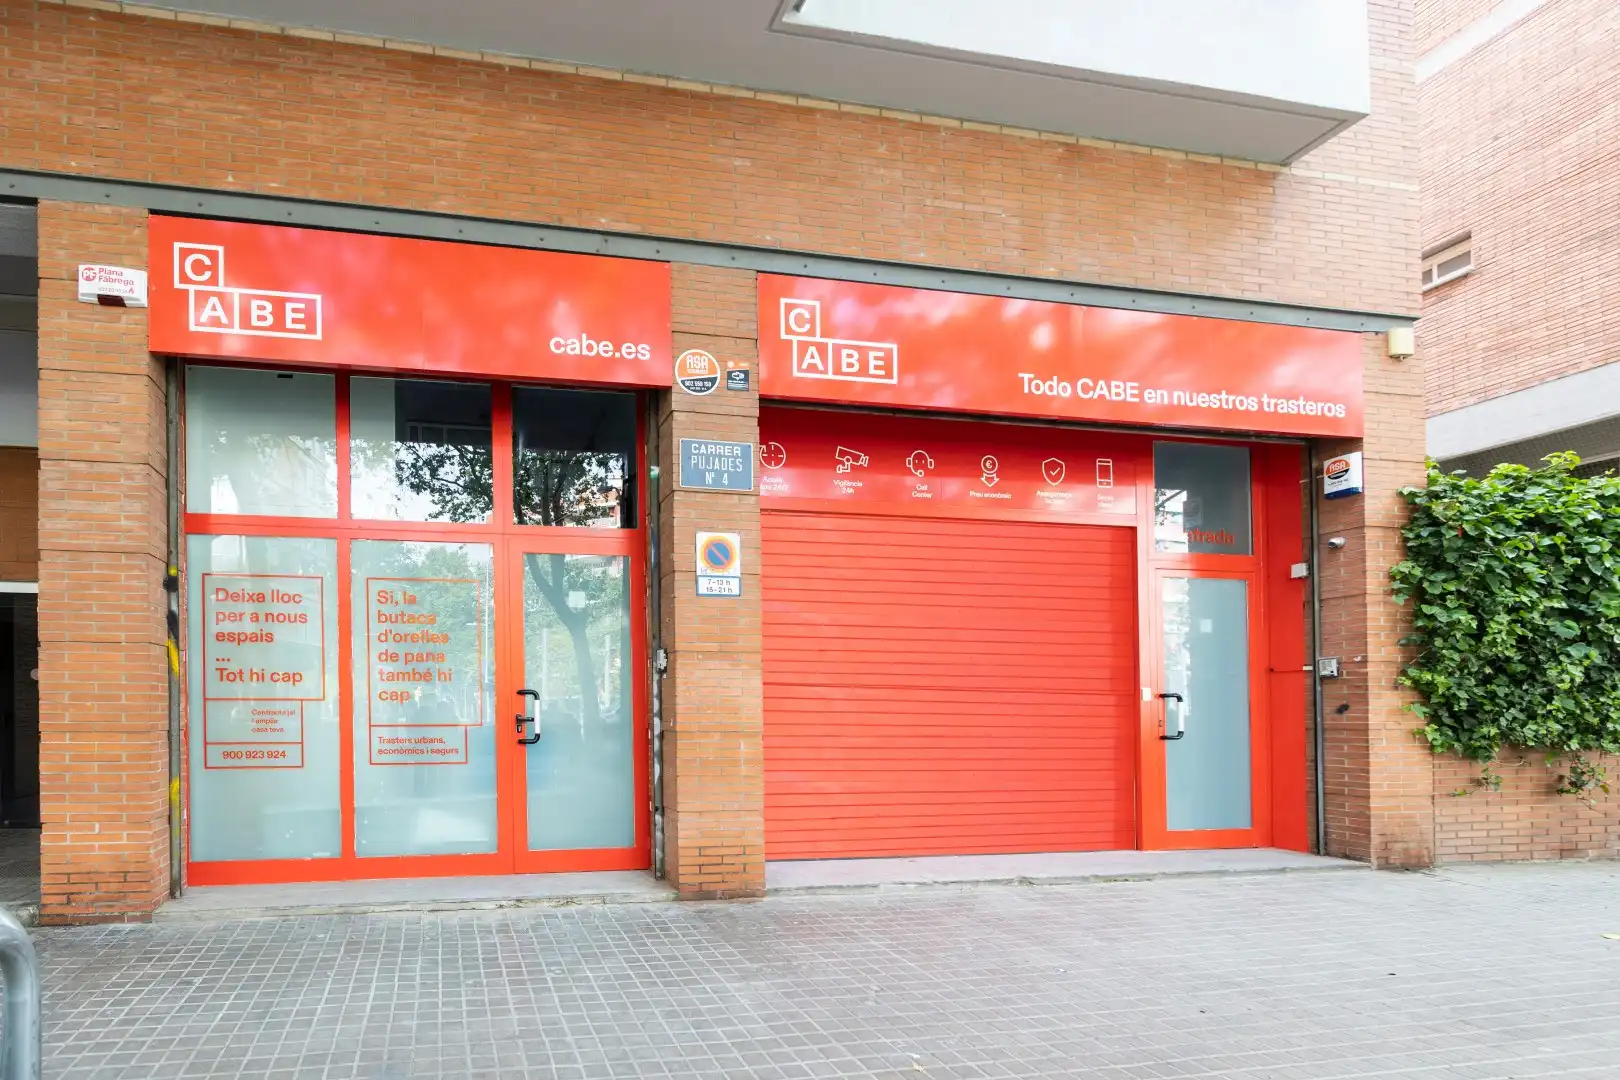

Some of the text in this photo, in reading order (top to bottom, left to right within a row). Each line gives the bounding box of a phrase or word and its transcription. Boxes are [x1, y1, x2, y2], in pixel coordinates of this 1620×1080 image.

[98, 267, 124, 277] Plana
[549, 332, 651, 361] cabe.es
[1018, 372, 1346, 418] Todo CABE en nuestros trasteros
[691, 443, 741, 457] CARRER
[691, 455, 743, 472] PUJADES
[722, 472, 729, 486] 4
[1188, 527, 1235, 546] ntrada
[215, 587, 303, 604] Deixa lloc
[402, 591, 417, 605] la
[215, 611, 308, 626] per a nous
[377, 609, 437, 625] butaca
[215, 628, 274, 646] espais
[377, 629, 449, 644] d'orelles
[377, 649, 446, 666] de pana
[215, 667, 303, 687] Tot hi cap
[377, 668, 452, 683] també hi
[378, 690, 411, 705] cap
[378, 735, 447, 745] Trasters urbans,
[222, 750, 287, 760] 900 923 924
[430, 748, 460, 757] segurs
